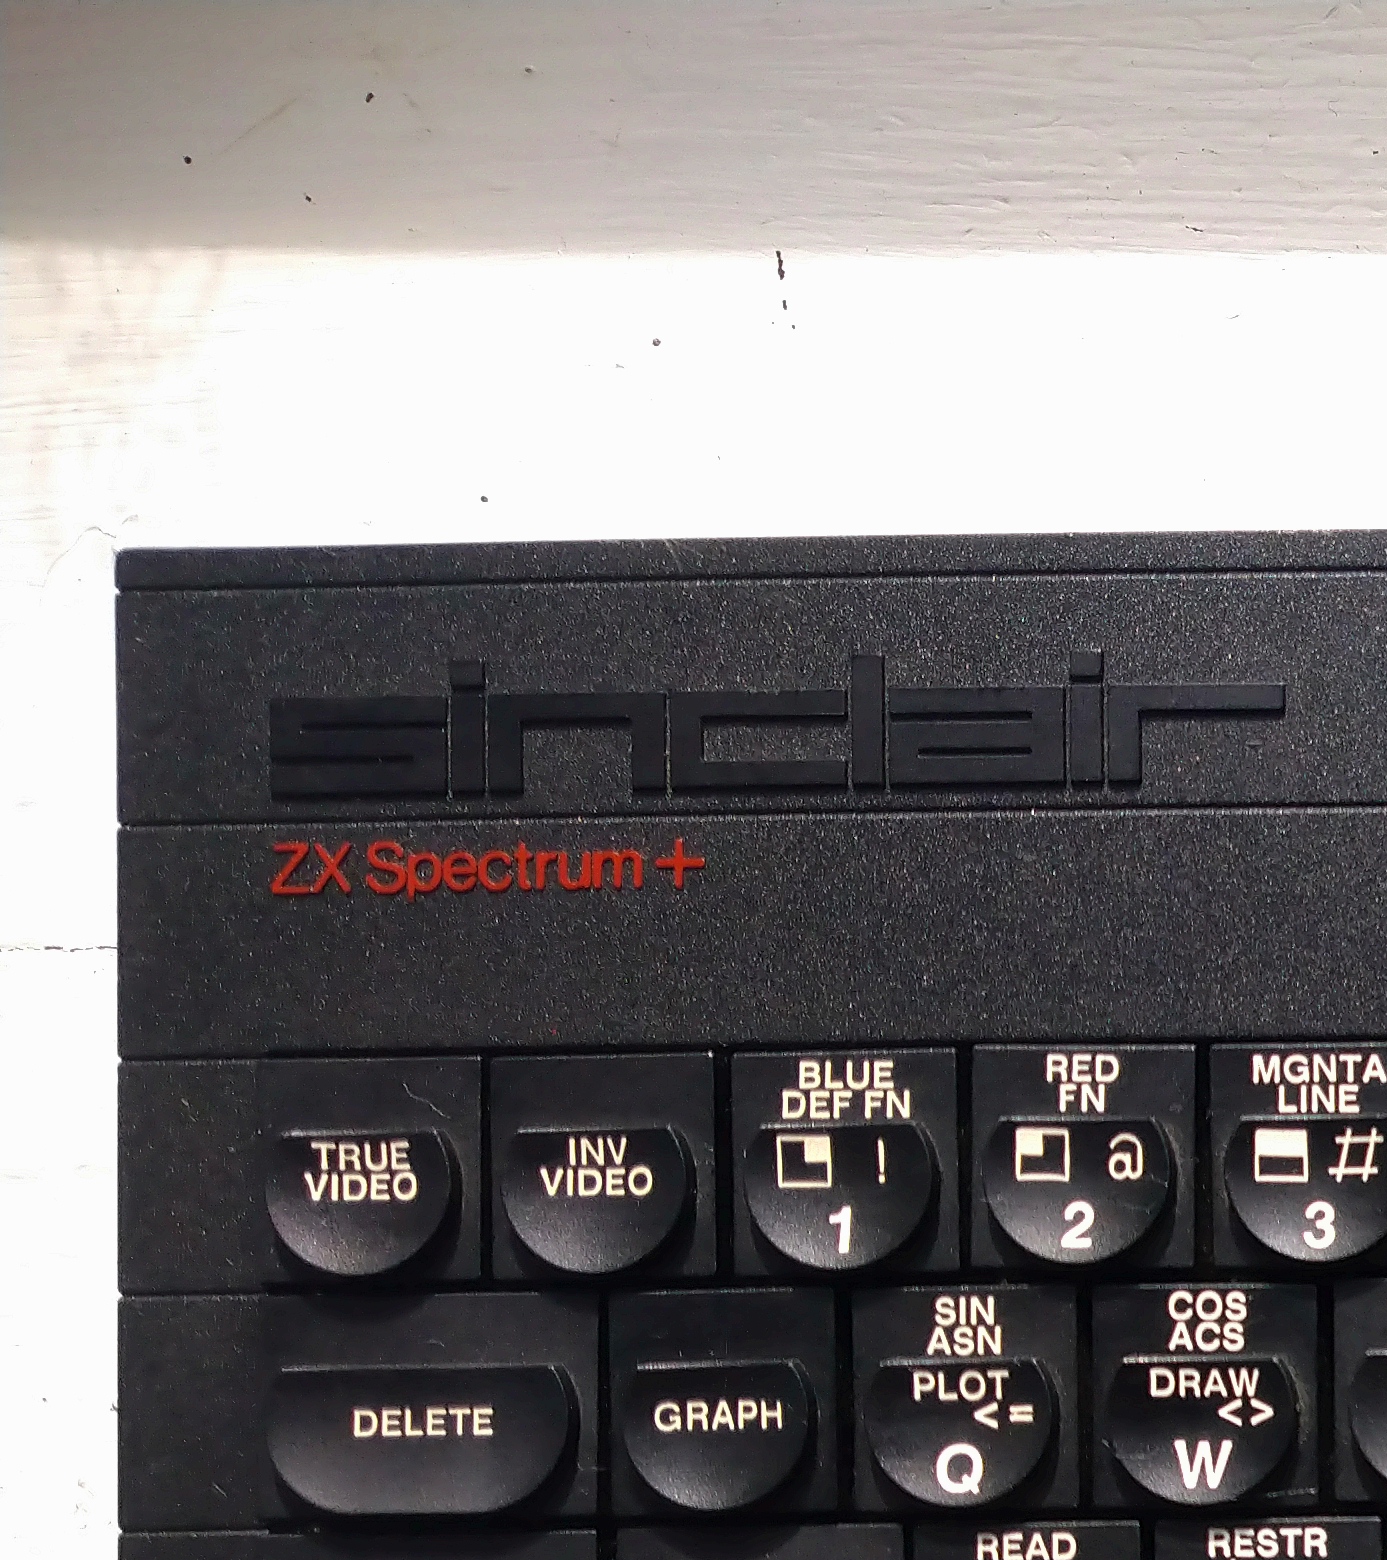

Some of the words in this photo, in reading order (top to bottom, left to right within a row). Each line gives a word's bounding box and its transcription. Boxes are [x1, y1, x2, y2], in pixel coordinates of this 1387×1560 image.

[270, 652, 1285, 799] sinclair
[271, 842, 351, 893] ZX
[366, 841, 641, 896] Spectrum
[798, 1059, 894, 1091] BLUE
[1046, 1053, 1120, 1083] RED
[1252, 1053, 1387, 1085] MGNTA
[781, 1089, 853, 1120] DEF
[864, 1089, 911, 1119] FN
[1059, 1082, 1106, 1113] FN
[1278, 1083, 1360, 1114] LINE
[310, 1141, 410, 1172] TRUE
[568, 1136, 627, 1167] INV
[304, 1171, 418, 1202] VIDEO
[539, 1165, 653, 1197] VIDEO
[828, 1205, 852, 1255] 1
[1060, 1200, 1095, 1250] 2
[1302, 1200, 1336, 1250] 3
[934, 1295, 995, 1327] SIN
[1168, 1289, 1247, 1321] COS
[926, 1325, 1002, 1357] ASN
[1168, 1322, 1245, 1352] ACS
[912, 1369, 1009, 1402] PLOT
[1149, 1367, 1260, 1398] DRAW
[353, 1407, 494, 1438] DELETE
[654, 1399, 783, 1433] GRAPH
[935, 1443, 984, 1495] Q
[1173, 1439, 1233, 1491] W
[1208, 1526, 1328, 1559] RESTR
